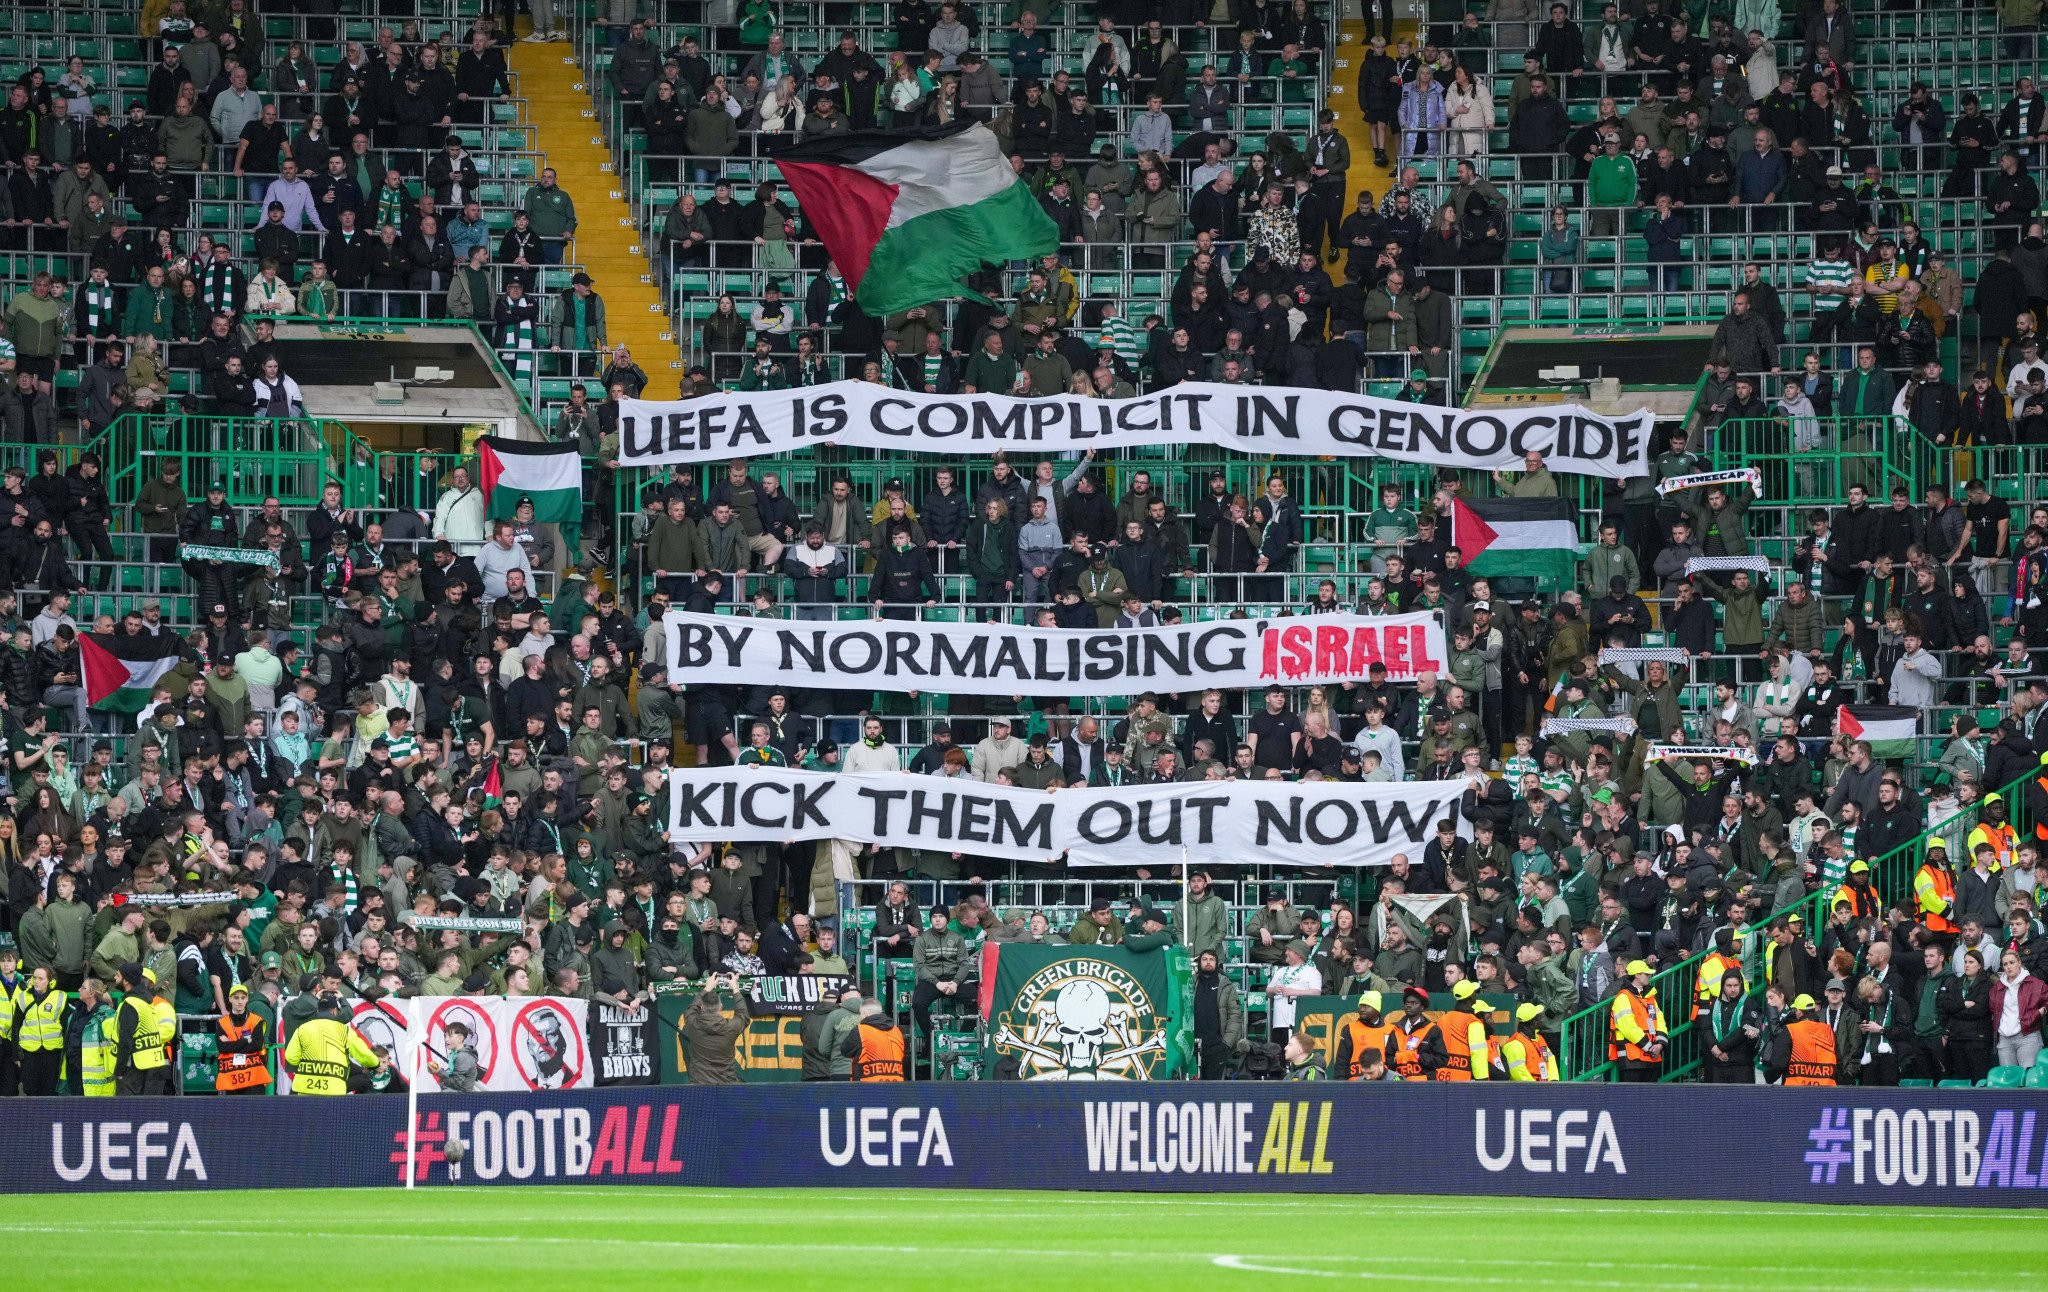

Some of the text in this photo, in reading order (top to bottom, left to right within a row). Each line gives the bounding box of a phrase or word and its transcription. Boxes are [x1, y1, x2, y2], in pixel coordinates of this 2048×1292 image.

[582, 109, 593, 117] PP
[1585, 327, 1615, 335] EXIT
[670, 361, 682, 369] EE
[622, 394, 1642, 465] UEFA IS COMPLICIT IN GENOCIDE
[1687, 471, 1746, 484] KNEECAP
[678, 624, 753, 668] BY
[777, 627, 1246, 683] NORMALISING
[680, 781, 836, 830] KICK
[858, 787, 1054, 850] THEM
[1078, 797, 1231, 846] OUT
[750, 975, 800, 1003] FUCK
[802, 976, 849, 1003] UEF
[1018, 962, 1073, 1013] GREEN
[1077, 961, 1152, 1017] BRIGADE
[230, 1072, 252, 1086] 387
[298, 1061, 345, 1078] STEWARD
[307, 1079, 329, 1090] 243
[602, 1055, 651, 1079] BHOYS
[52, 1122, 208, 1182] UEFA
[389, 1104, 684, 1181] #FOOTBALL
[820, 1107, 954, 1168] UEFA
[1084, 1101, 1334, 1174] WELCOME ALL
[1476, 1109, 1628, 1175] UEFA
